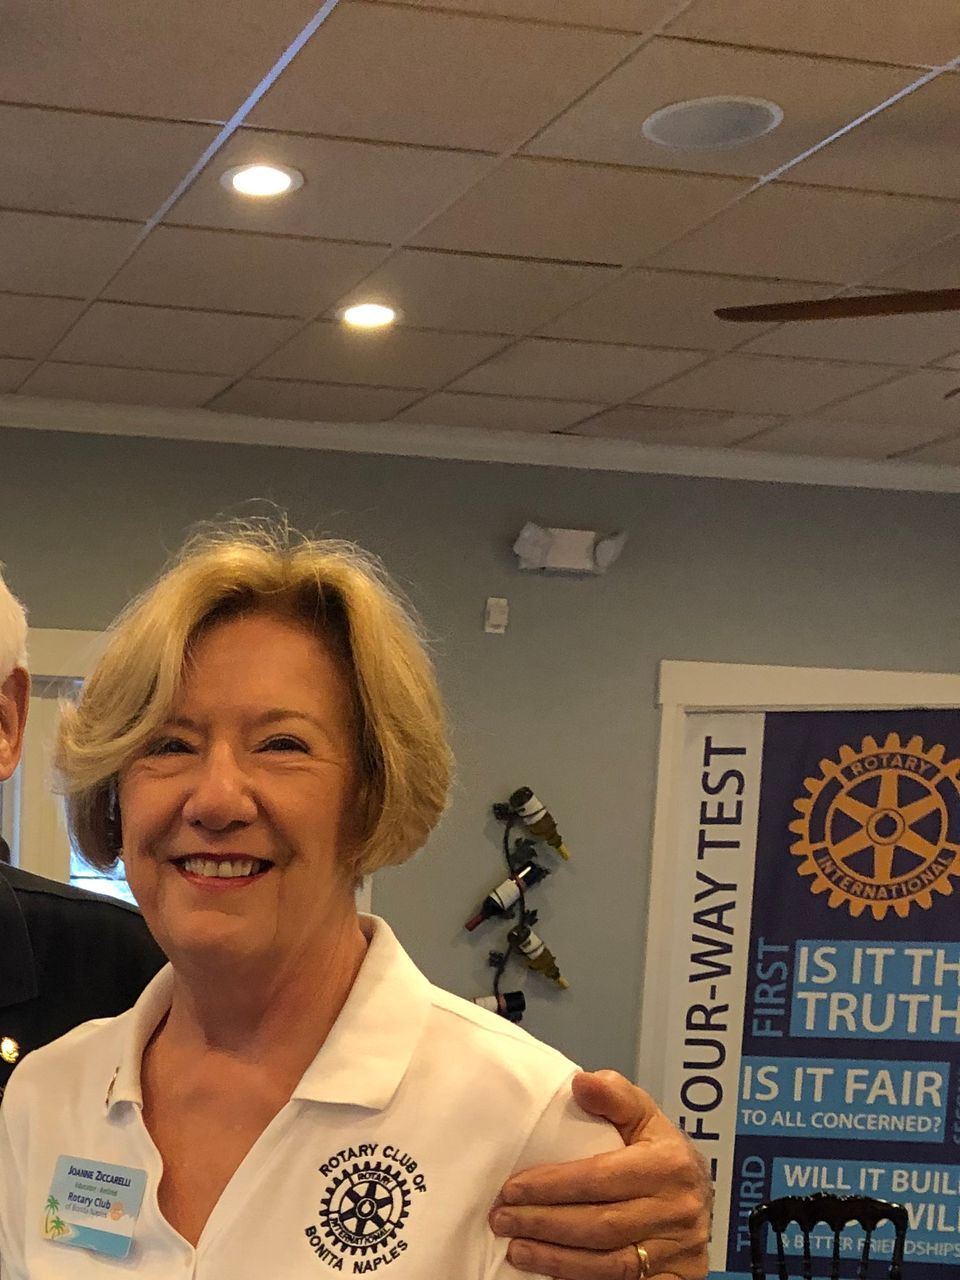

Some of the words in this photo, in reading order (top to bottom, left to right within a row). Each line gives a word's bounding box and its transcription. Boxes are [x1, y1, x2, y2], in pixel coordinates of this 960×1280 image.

[851, 753, 934, 777] ROTARY
[697, 736, 747, 860] TEST
[817, 850, 953, 900] INTERNATIONAL
[798, 946, 838, 984] IS
[851, 947, 896, 985] IT
[679, 870, 738, 1141] FOUR-WAY
[751, 936, 790, 1038] FIRST
[796, 990, 960, 1035] TRUTH
[742, 1064, 780, 1102] IS
[793, 1066, 835, 1103] IT
[844, 1068, 944, 1108] FAIR
[741, 1108, 767, 1126] TO
[771, 1110, 807, 1128] ALL
[811, 1111, 943, 1134] CONCERNED?
[67, 1165, 95, 1180] JOANNE
[95, 1170, 132, 1187] ZICCARELLI
[318, 1143, 379, 1178] ROTARY
[382, 1145, 418, 1174] CLUB
[412, 1174, 427, 1193] OF
[357, 1171, 393, 1187] ROTARY
[783, 1164, 852, 1190] WILL
[859, 1167, 886, 1192] IT
[891, 1169, 960, 1196] BUIL
[67, 1191, 93, 1208] Rotary
[94, 1197, 112, 1210] Club
[304, 1225, 344, 1272] BONITA
[352, 1239, 409, 1275] NAPLES
[794, 1234, 854, 1251] BTTR
